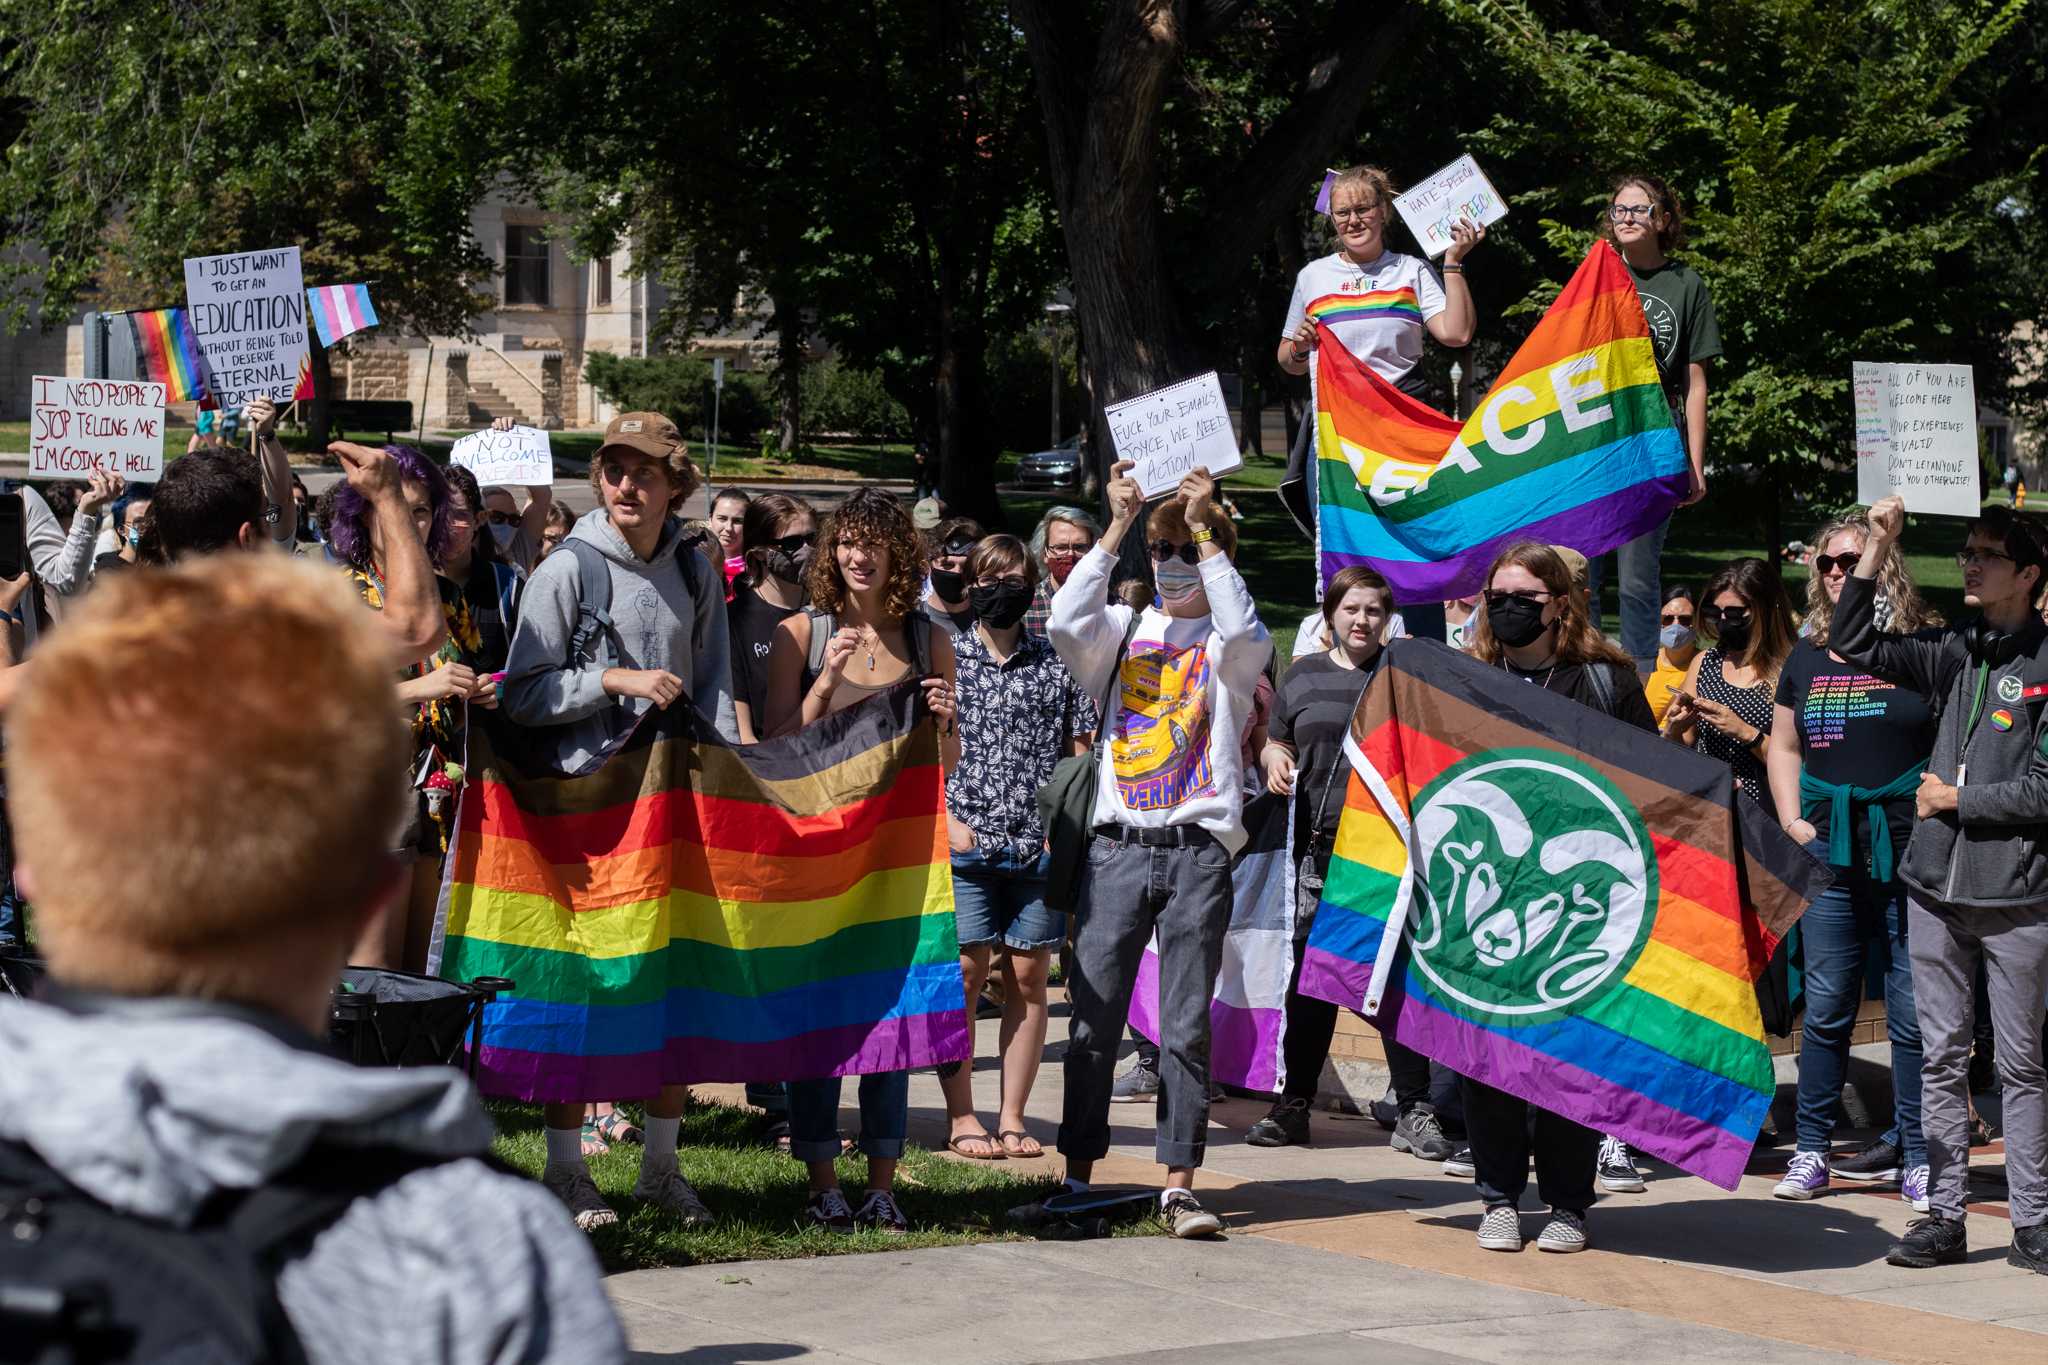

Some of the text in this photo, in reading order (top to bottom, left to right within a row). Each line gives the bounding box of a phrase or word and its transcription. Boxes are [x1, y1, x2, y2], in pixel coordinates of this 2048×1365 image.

[1408, 187, 1440, 213] HATE
[198, 252, 290, 277] I JUST WANT
[211, 278, 266, 293] TO GET AN
[193, 292, 302, 336] EDUCATION
[196, 331, 303, 357] WITHOUT BEING TOLD
[220, 351, 275, 367] I DESERVE
[210, 363, 296, 389] ETERNAL
[1888, 372, 1901, 388] ALL
[1906, 369, 1921, 386] OF
[1926, 373, 1942, 386] YOU
[1947, 374, 1967, 388] ARE
[35, 378, 165, 408] I NEED PEOPLE 2
[1888, 393, 1927, 408] WELCOME
[1931, 395, 1952, 405] HERE
[35, 408, 71, 441] STOP
[133, 418, 159, 439] ME
[1113, 420, 1144, 444] FUCK
[1146, 408, 1174, 426] YOUR
[1171, 425, 1190, 444] WE
[1196, 415, 1228, 438] NEED
[1889, 418, 1909, 436] YOUR
[478, 435, 532, 452] NOT
[1901, 438, 1934, 452] VALID
[109, 451, 120, 472] 2
[126, 452, 155, 472] HELL
[455, 449, 548, 470] WELCOME
[1888, 474, 1902, 486] TELL
[1906, 474, 1921, 485] YOU
[1850, 684, 1896, 692] IGNORANCE
[1804, 705, 1822, 713] LOVE
[1848, 702, 1887, 710] BARRIERS
[1848, 709, 1885, 718] BORDERS
[1804, 719, 1822, 727] LOVE
